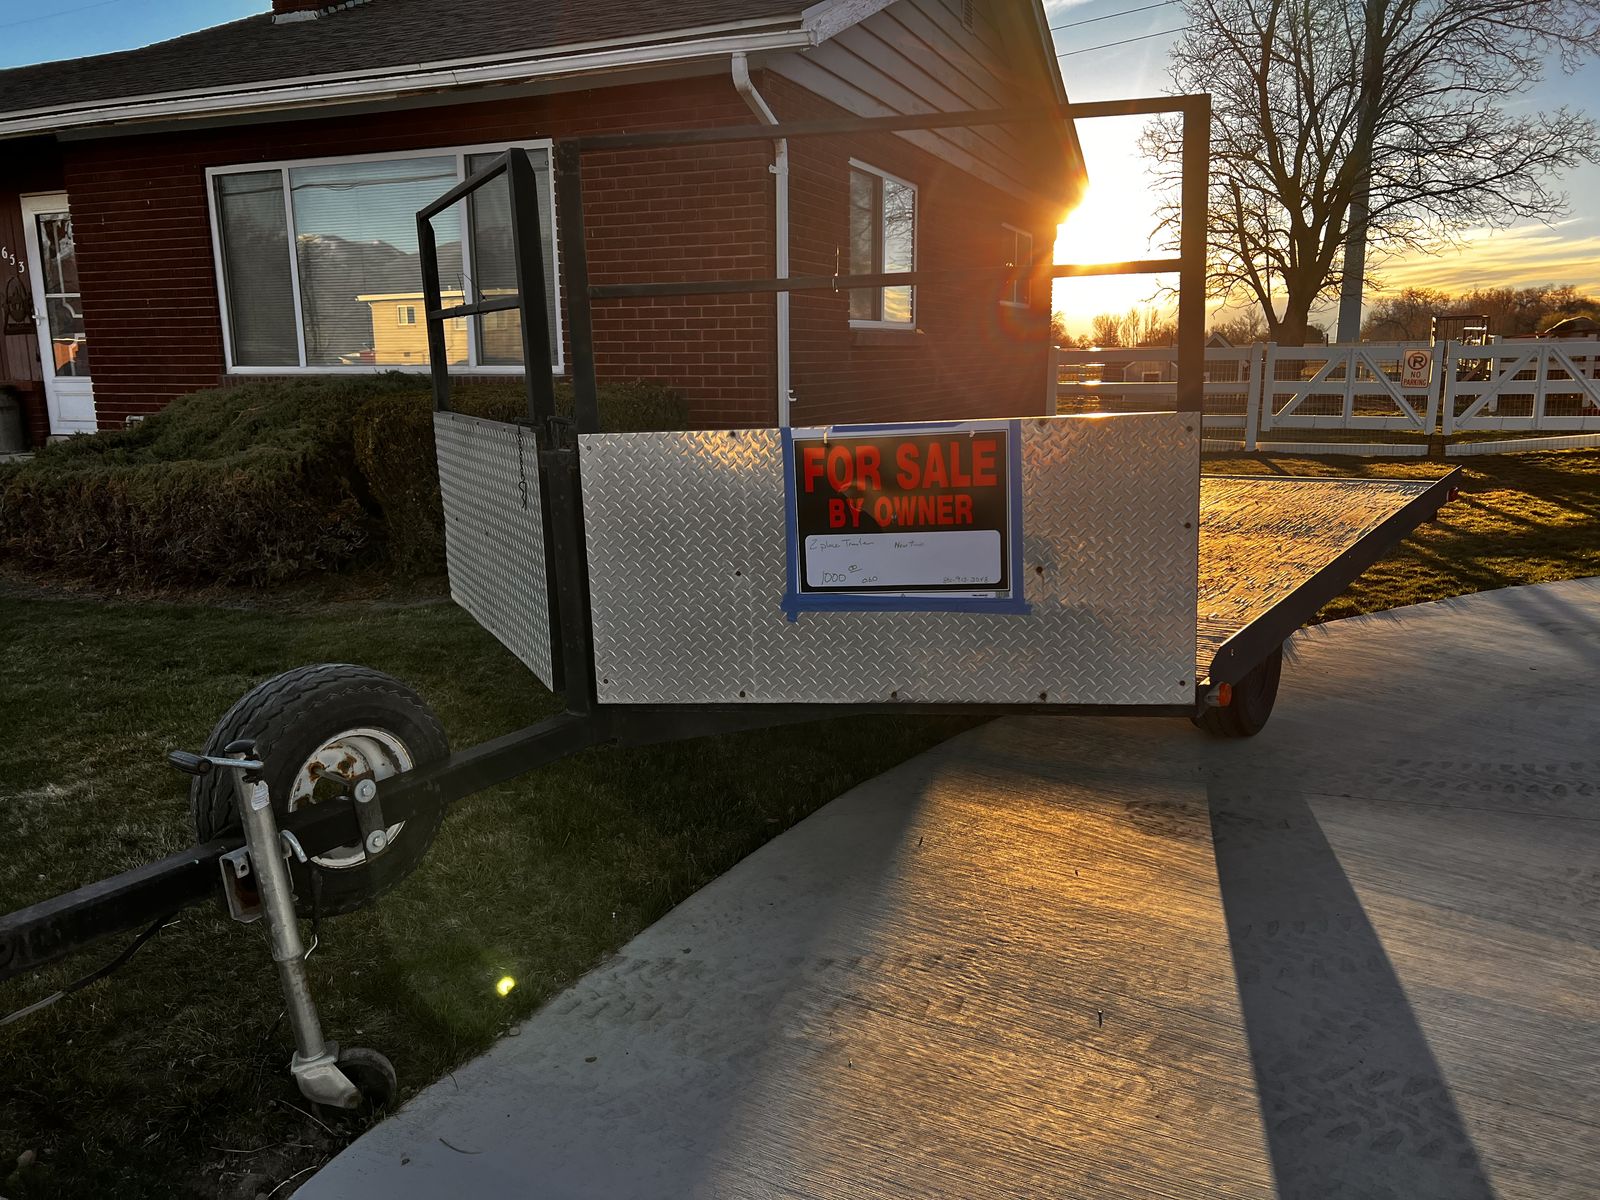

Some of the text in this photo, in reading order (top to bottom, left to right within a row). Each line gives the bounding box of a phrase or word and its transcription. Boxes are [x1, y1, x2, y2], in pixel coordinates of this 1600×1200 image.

[1, 246, 25, 273] 653
[1410, 371, 1421, 379] NO
[803, 439, 998, 493] FOR SALE
[828, 494, 973, 528] BY OWNER
[821, 570, 847, 585] 1000
